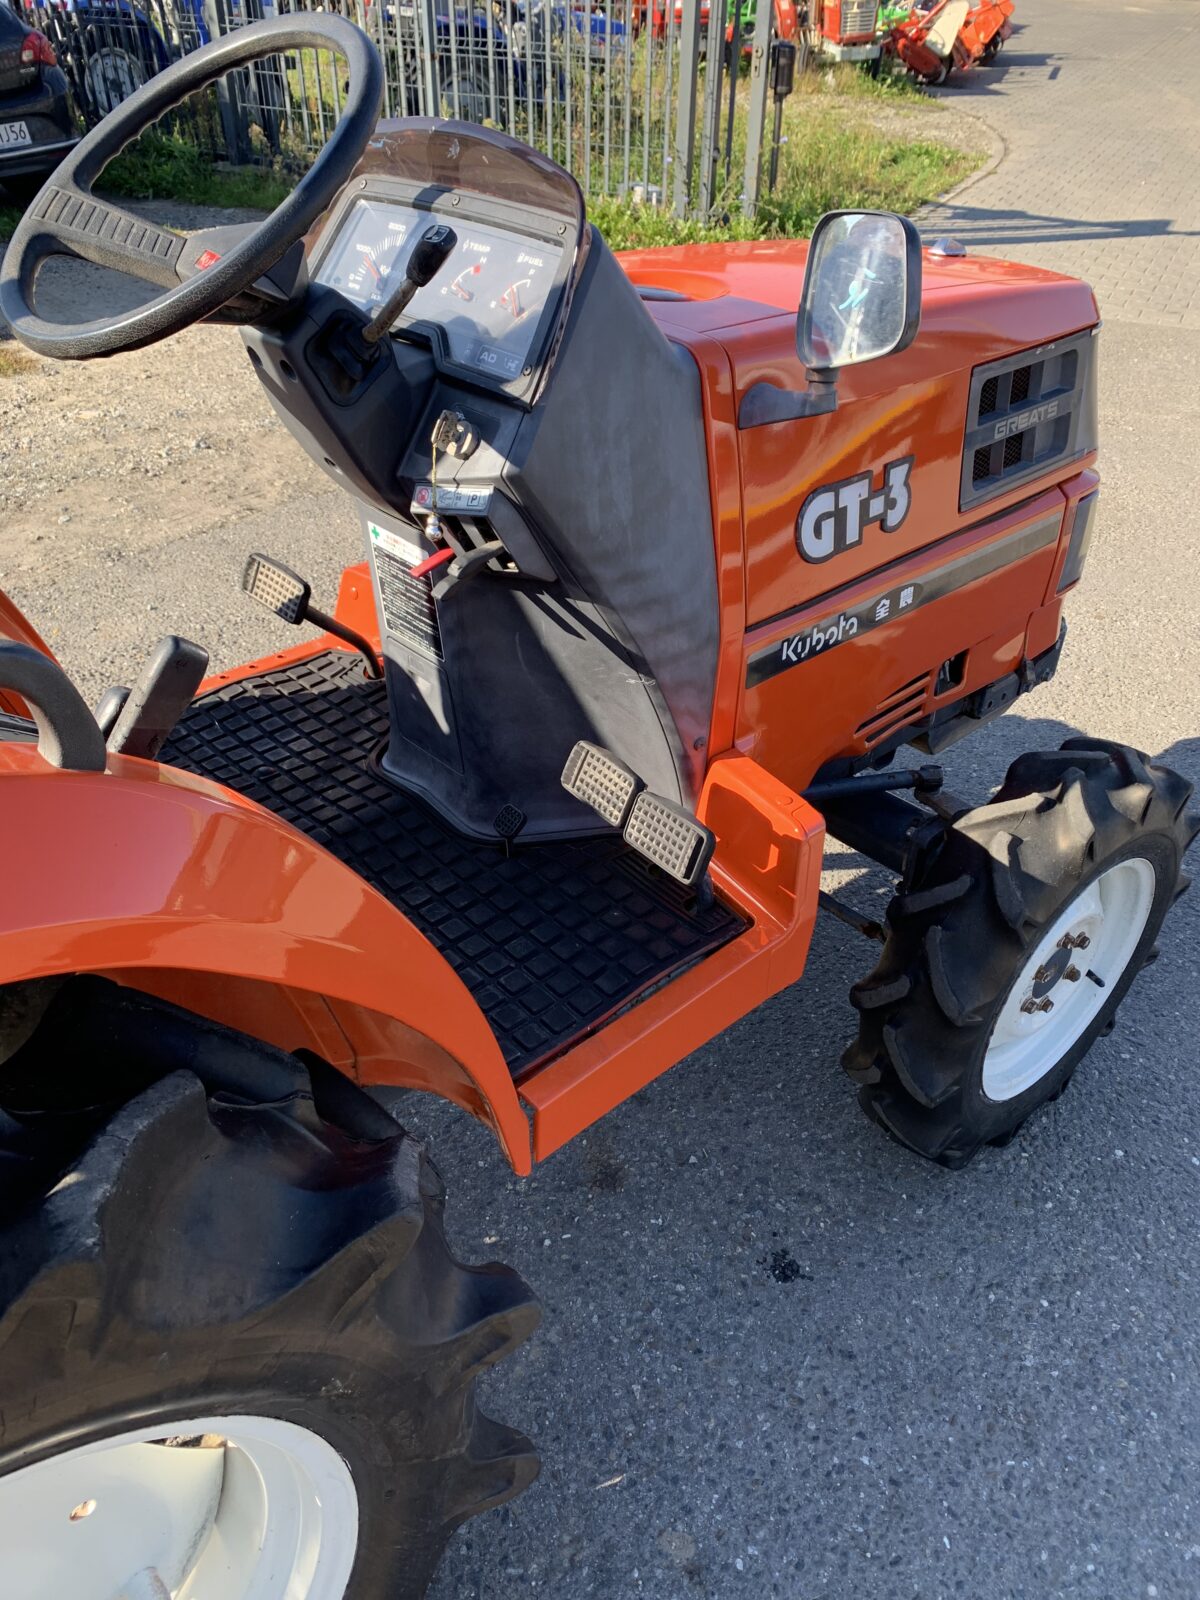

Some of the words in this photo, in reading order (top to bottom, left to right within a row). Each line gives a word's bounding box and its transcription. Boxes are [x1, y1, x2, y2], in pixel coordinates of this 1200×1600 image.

[469, 243, 491, 252] TEMP
[523, 255, 544, 267] FUEL
[480, 351, 497, 363] AD
[993, 401, 1058, 440] GREATS
[471, 494, 478, 504] P
[799, 461, 912, 560] GT-3
[781, 614, 858, 662] Kubota
